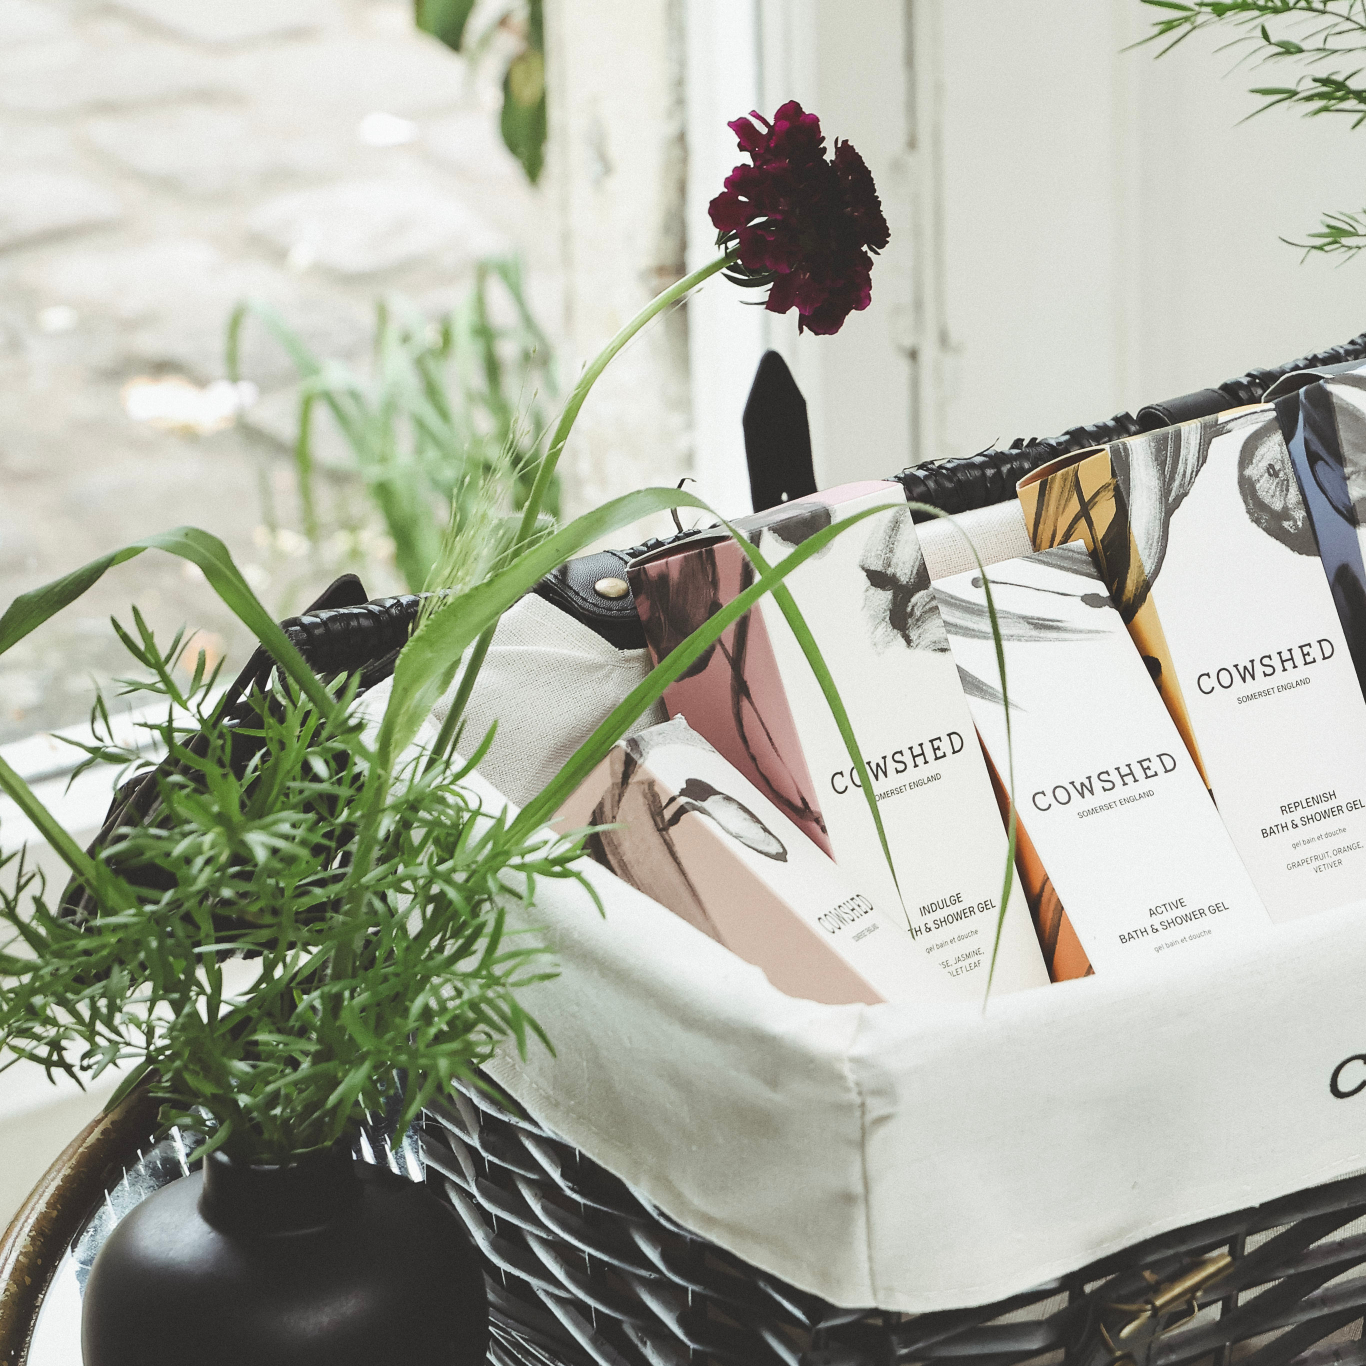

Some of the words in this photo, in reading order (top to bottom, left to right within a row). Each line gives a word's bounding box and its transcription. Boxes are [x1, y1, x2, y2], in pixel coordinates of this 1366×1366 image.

[1197, 638, 1335, 695] COWSHED
[1237, 687, 1276, 705] SOMERSET
[1277, 677, 1311, 693] ENGLAND
[875, 784, 907, 803] OMERSET
[908, 772, 942, 790] ENGLAND
[1031, 752, 1177, 812] COWSHED
[1077, 800, 1118, 819] SOMERSET
[1119, 789, 1155, 806] ENGLAND
[1280, 789, 1337, 816] REPLENISH
[1261, 822, 1289, 839] BATH
[1291, 819, 1299, 830] &
[1300, 805, 1345, 827] SHOWER
[1345, 798, 1366, 812] GEL
[1291, 840, 1302, 850] gel
[1302, 837, 1316, 846] bain
[1324, 827, 1347, 839] douche
[1286, 850, 1332, 871] GRAPEFRUIT,
[1313, 858, 1343, 874] VETIVER
[817, 894, 874, 934] COWSHED
[919, 892, 963, 917] INDULGE
[924, 922, 932, 933] &
[933, 907, 976, 930] SHOWER
[977, 898, 996, 916] GEL
[1148, 897, 1187, 918] ACTIVE
[1118, 926, 1149, 944] BATH
[1150, 924, 1159, 934] &
[1160, 907, 1208, 931] SHOWER
[1208, 901, 1230, 915] GEL
[1154, 944, 1165, 953] gel
[1188, 928, 1212, 941] douche
[965, 959, 982, 972] LEAF
